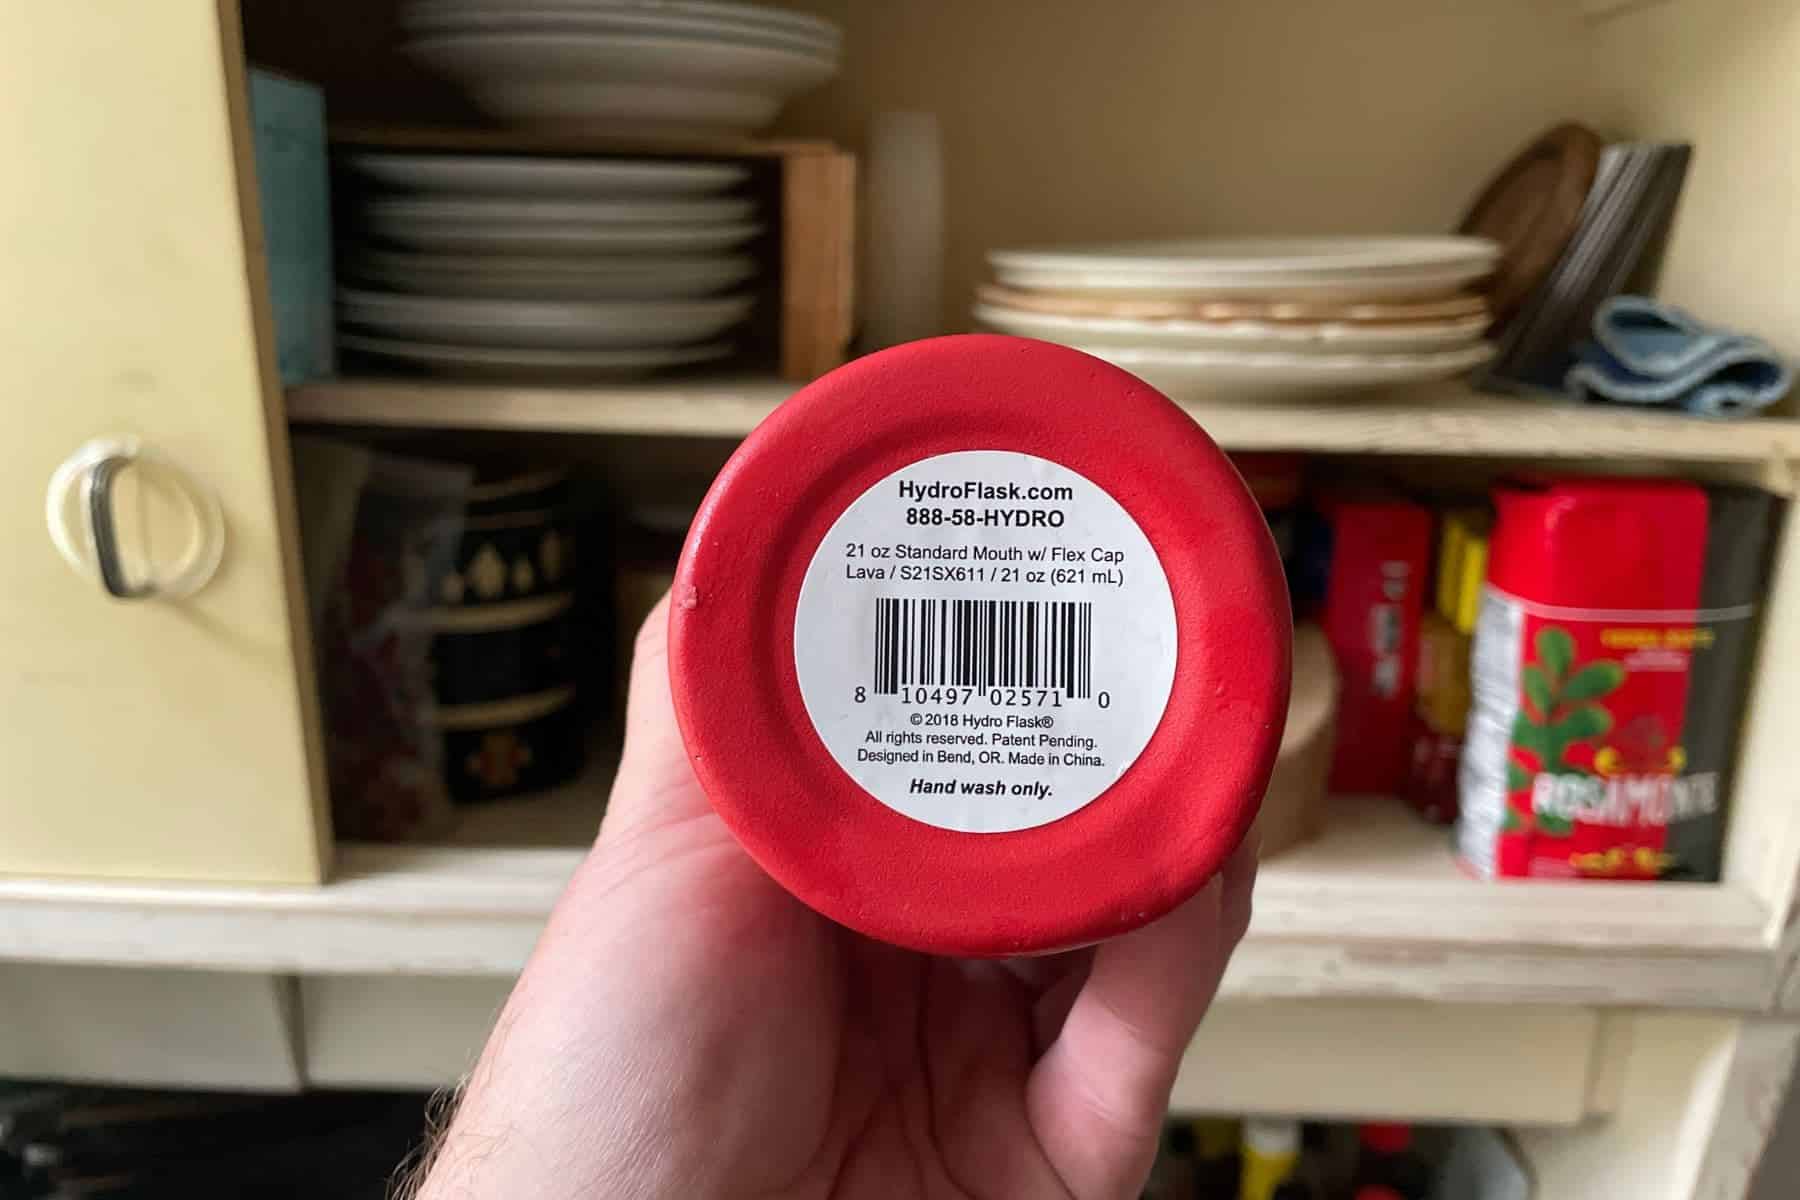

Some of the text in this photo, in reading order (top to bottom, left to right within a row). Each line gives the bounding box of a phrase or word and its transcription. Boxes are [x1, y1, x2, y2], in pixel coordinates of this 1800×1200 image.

[899, 480, 1072, 502] HydroFlask.com
[906, 508, 1064, 528] 888-58-HYDRO
[846, 544, 1124, 565] 21 oz Standard Mouth w/ Flex Cap
[846, 565, 1123, 587] Lava / S21SX611 / 21 oz (621 mL)
[854, 686, 1110, 709] 8 10497 02571 0
[963, 714, 1003, 730] Hydro
[865, 730, 1097, 750] All rights reserved. Patent Pending.
[858, 749, 1104, 767] Designed in Bend, OR. Made in China.
[909, 778, 1052, 800] Hand wash only.
